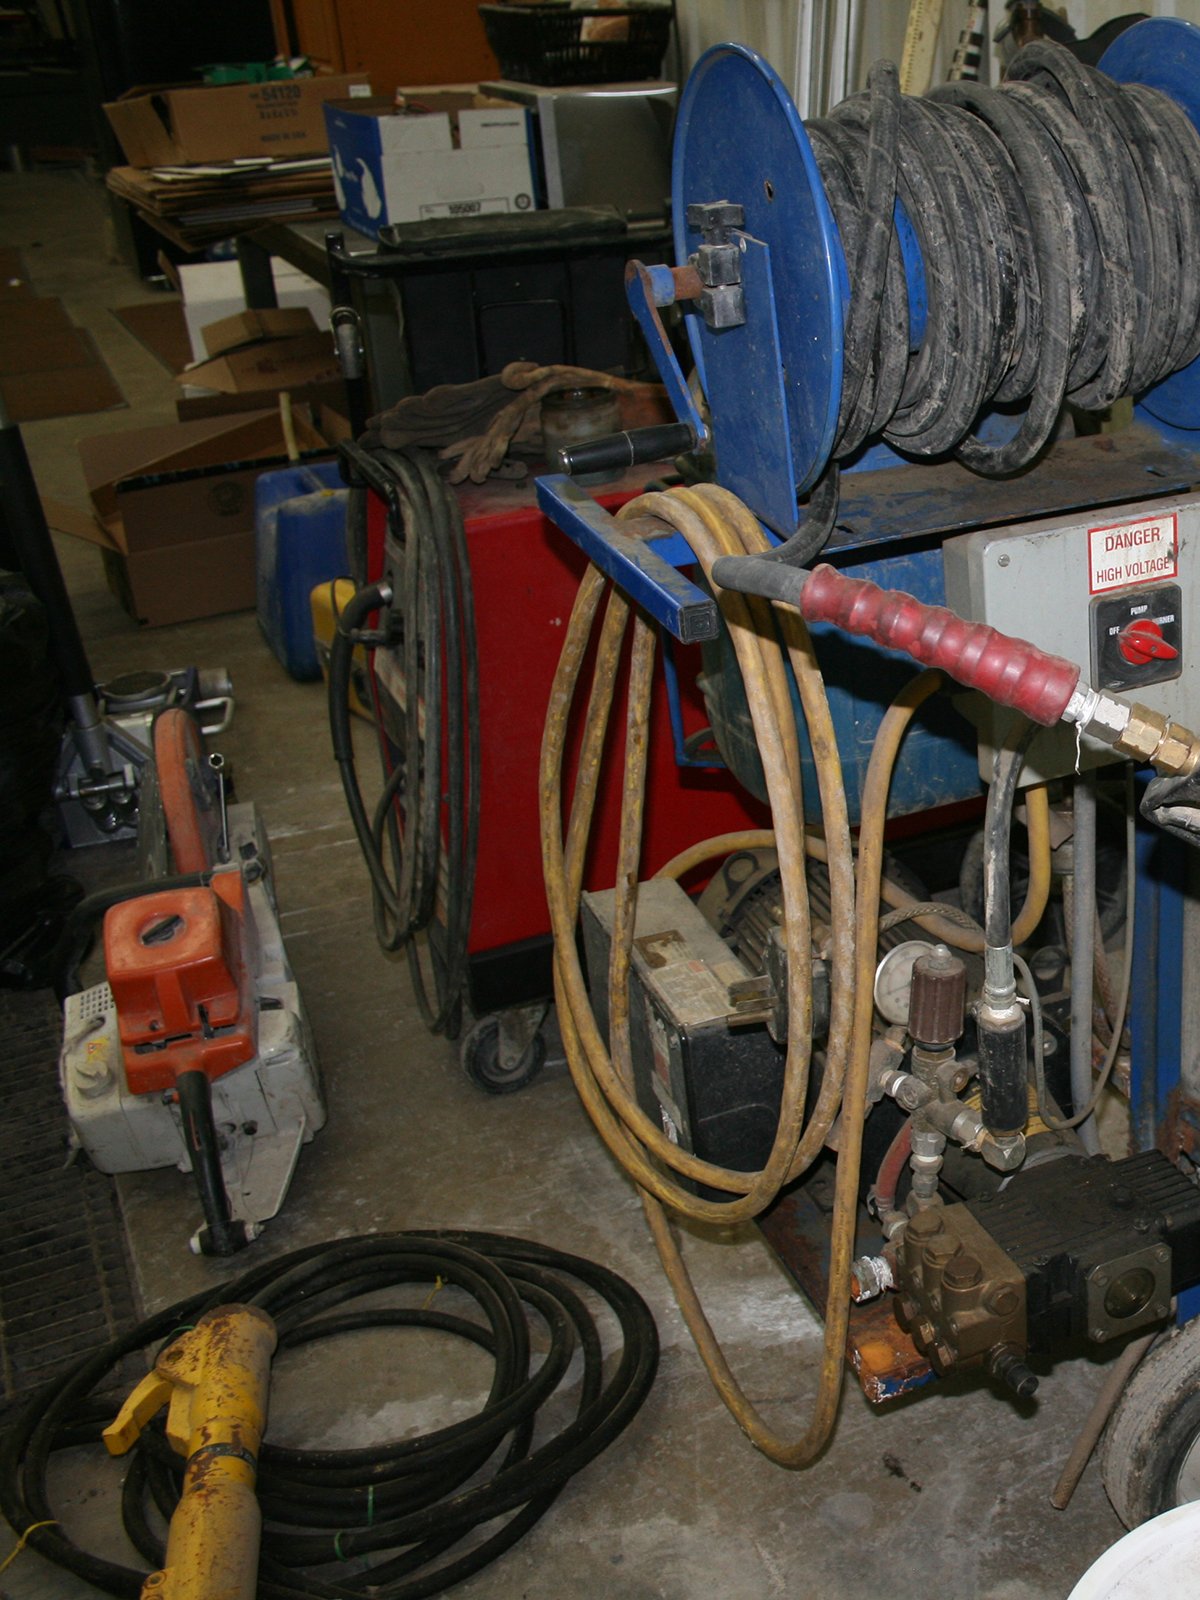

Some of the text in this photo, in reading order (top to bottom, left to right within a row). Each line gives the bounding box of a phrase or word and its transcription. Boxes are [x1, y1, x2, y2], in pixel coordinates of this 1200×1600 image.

[1105, 527, 1161, 552] DANGER
[1096, 557, 1170, 583] HIGH VOLTAGE
[1130, 605, 1148, 616] PUMP
[1109, 626, 1120, 636] OFF
